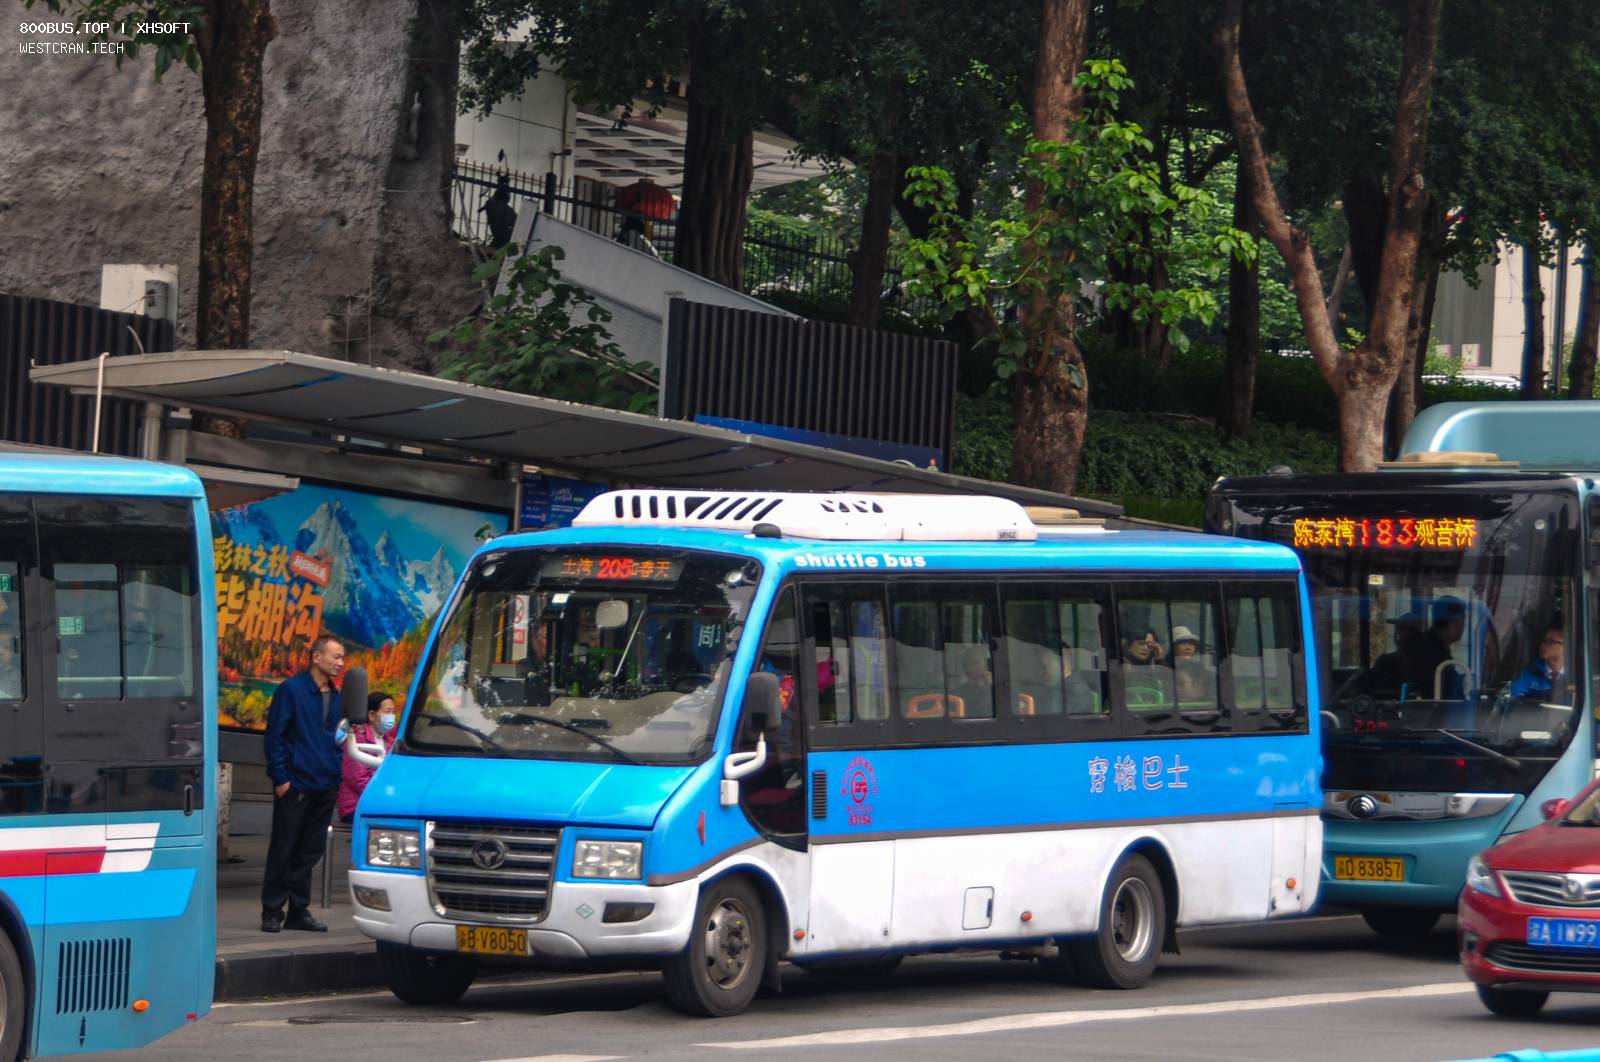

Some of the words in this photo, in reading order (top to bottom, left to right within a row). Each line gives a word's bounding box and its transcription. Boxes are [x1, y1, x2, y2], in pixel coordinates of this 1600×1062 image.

[1293, 517, 1356, 547] 陈家湾
[1359, 518, 1416, 547] 183
[1414, 517, 1477, 547] 观音桥
[214, 535, 291, 583] 彩林之秋
[596, 556, 634, 580] 205
[793, 552, 879, 567] shuttle
[882, 552, 927, 567] bus
[215, 573, 325, 650] 毕棚沟
[1087, 754, 1189, 793] 穿梭巴士
